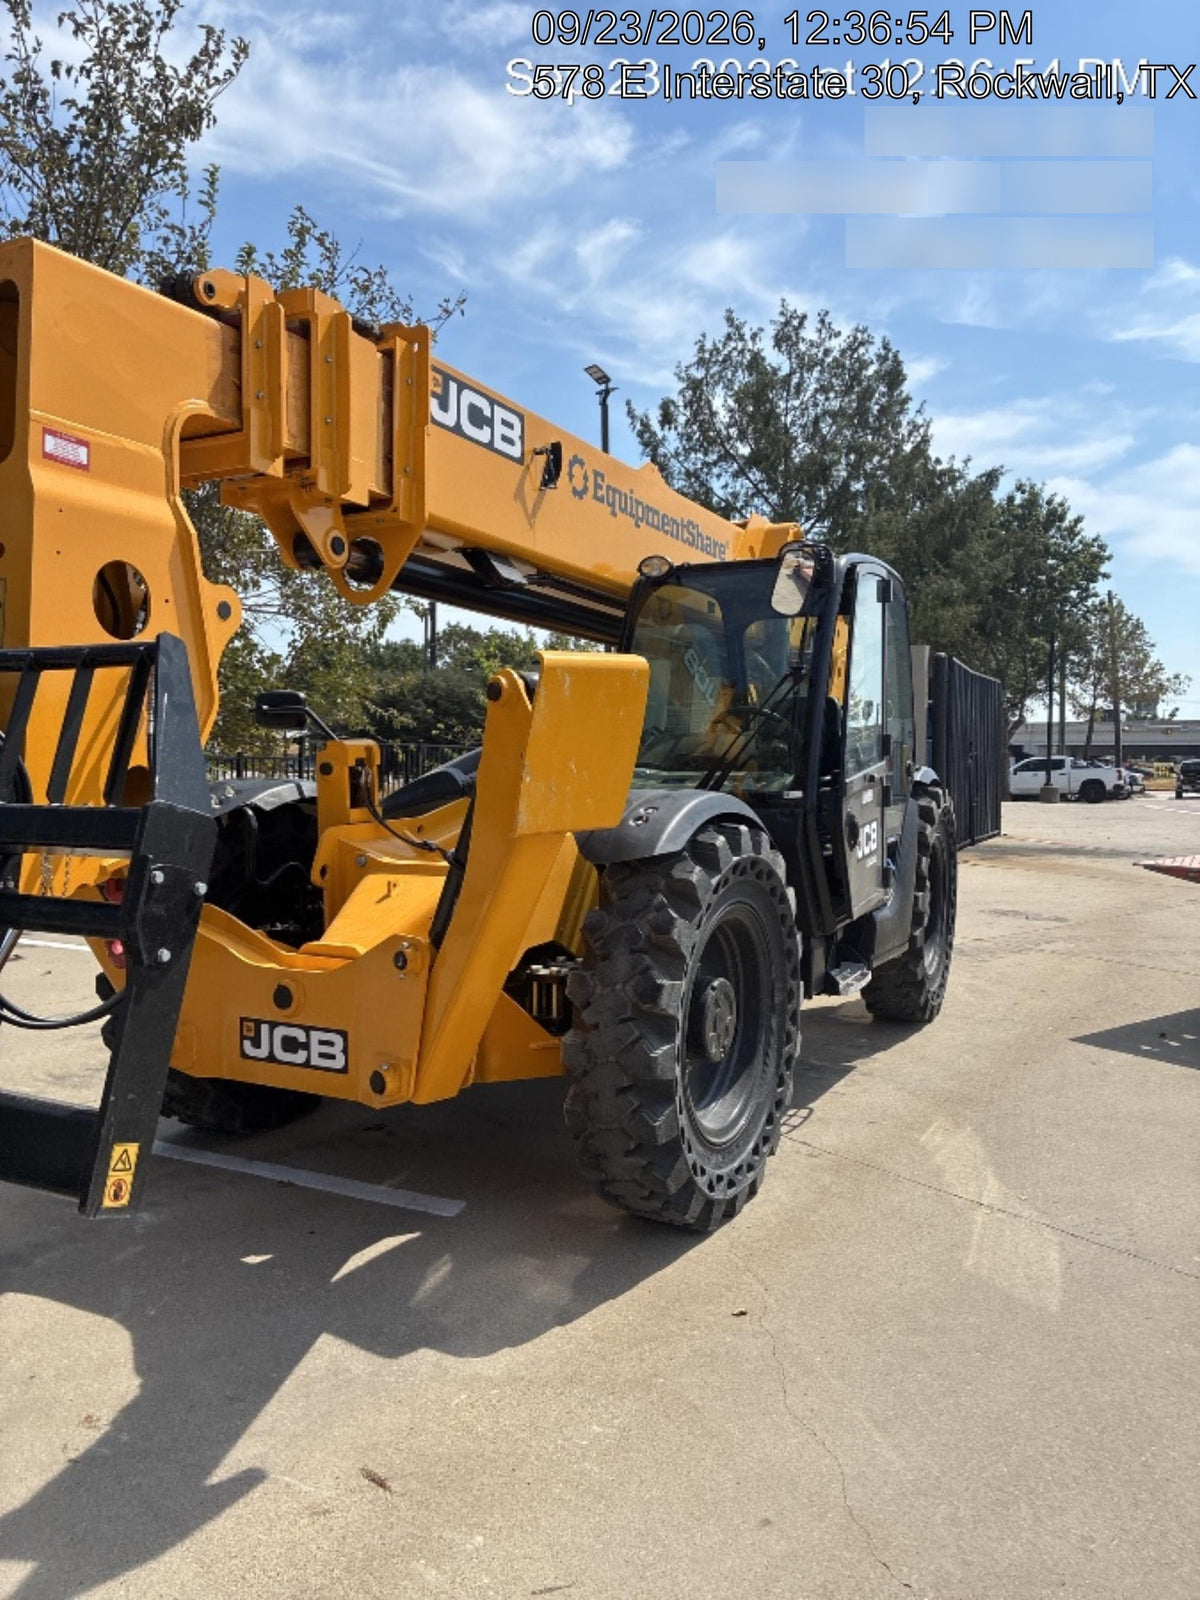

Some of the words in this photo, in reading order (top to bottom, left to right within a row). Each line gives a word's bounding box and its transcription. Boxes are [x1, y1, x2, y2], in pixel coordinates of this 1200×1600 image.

[430, 380, 522, 458] JCB
[592, 469, 726, 562] EquipmentShare
[857, 821, 878, 859] JCB
[242, 1023, 346, 1069] JCB
